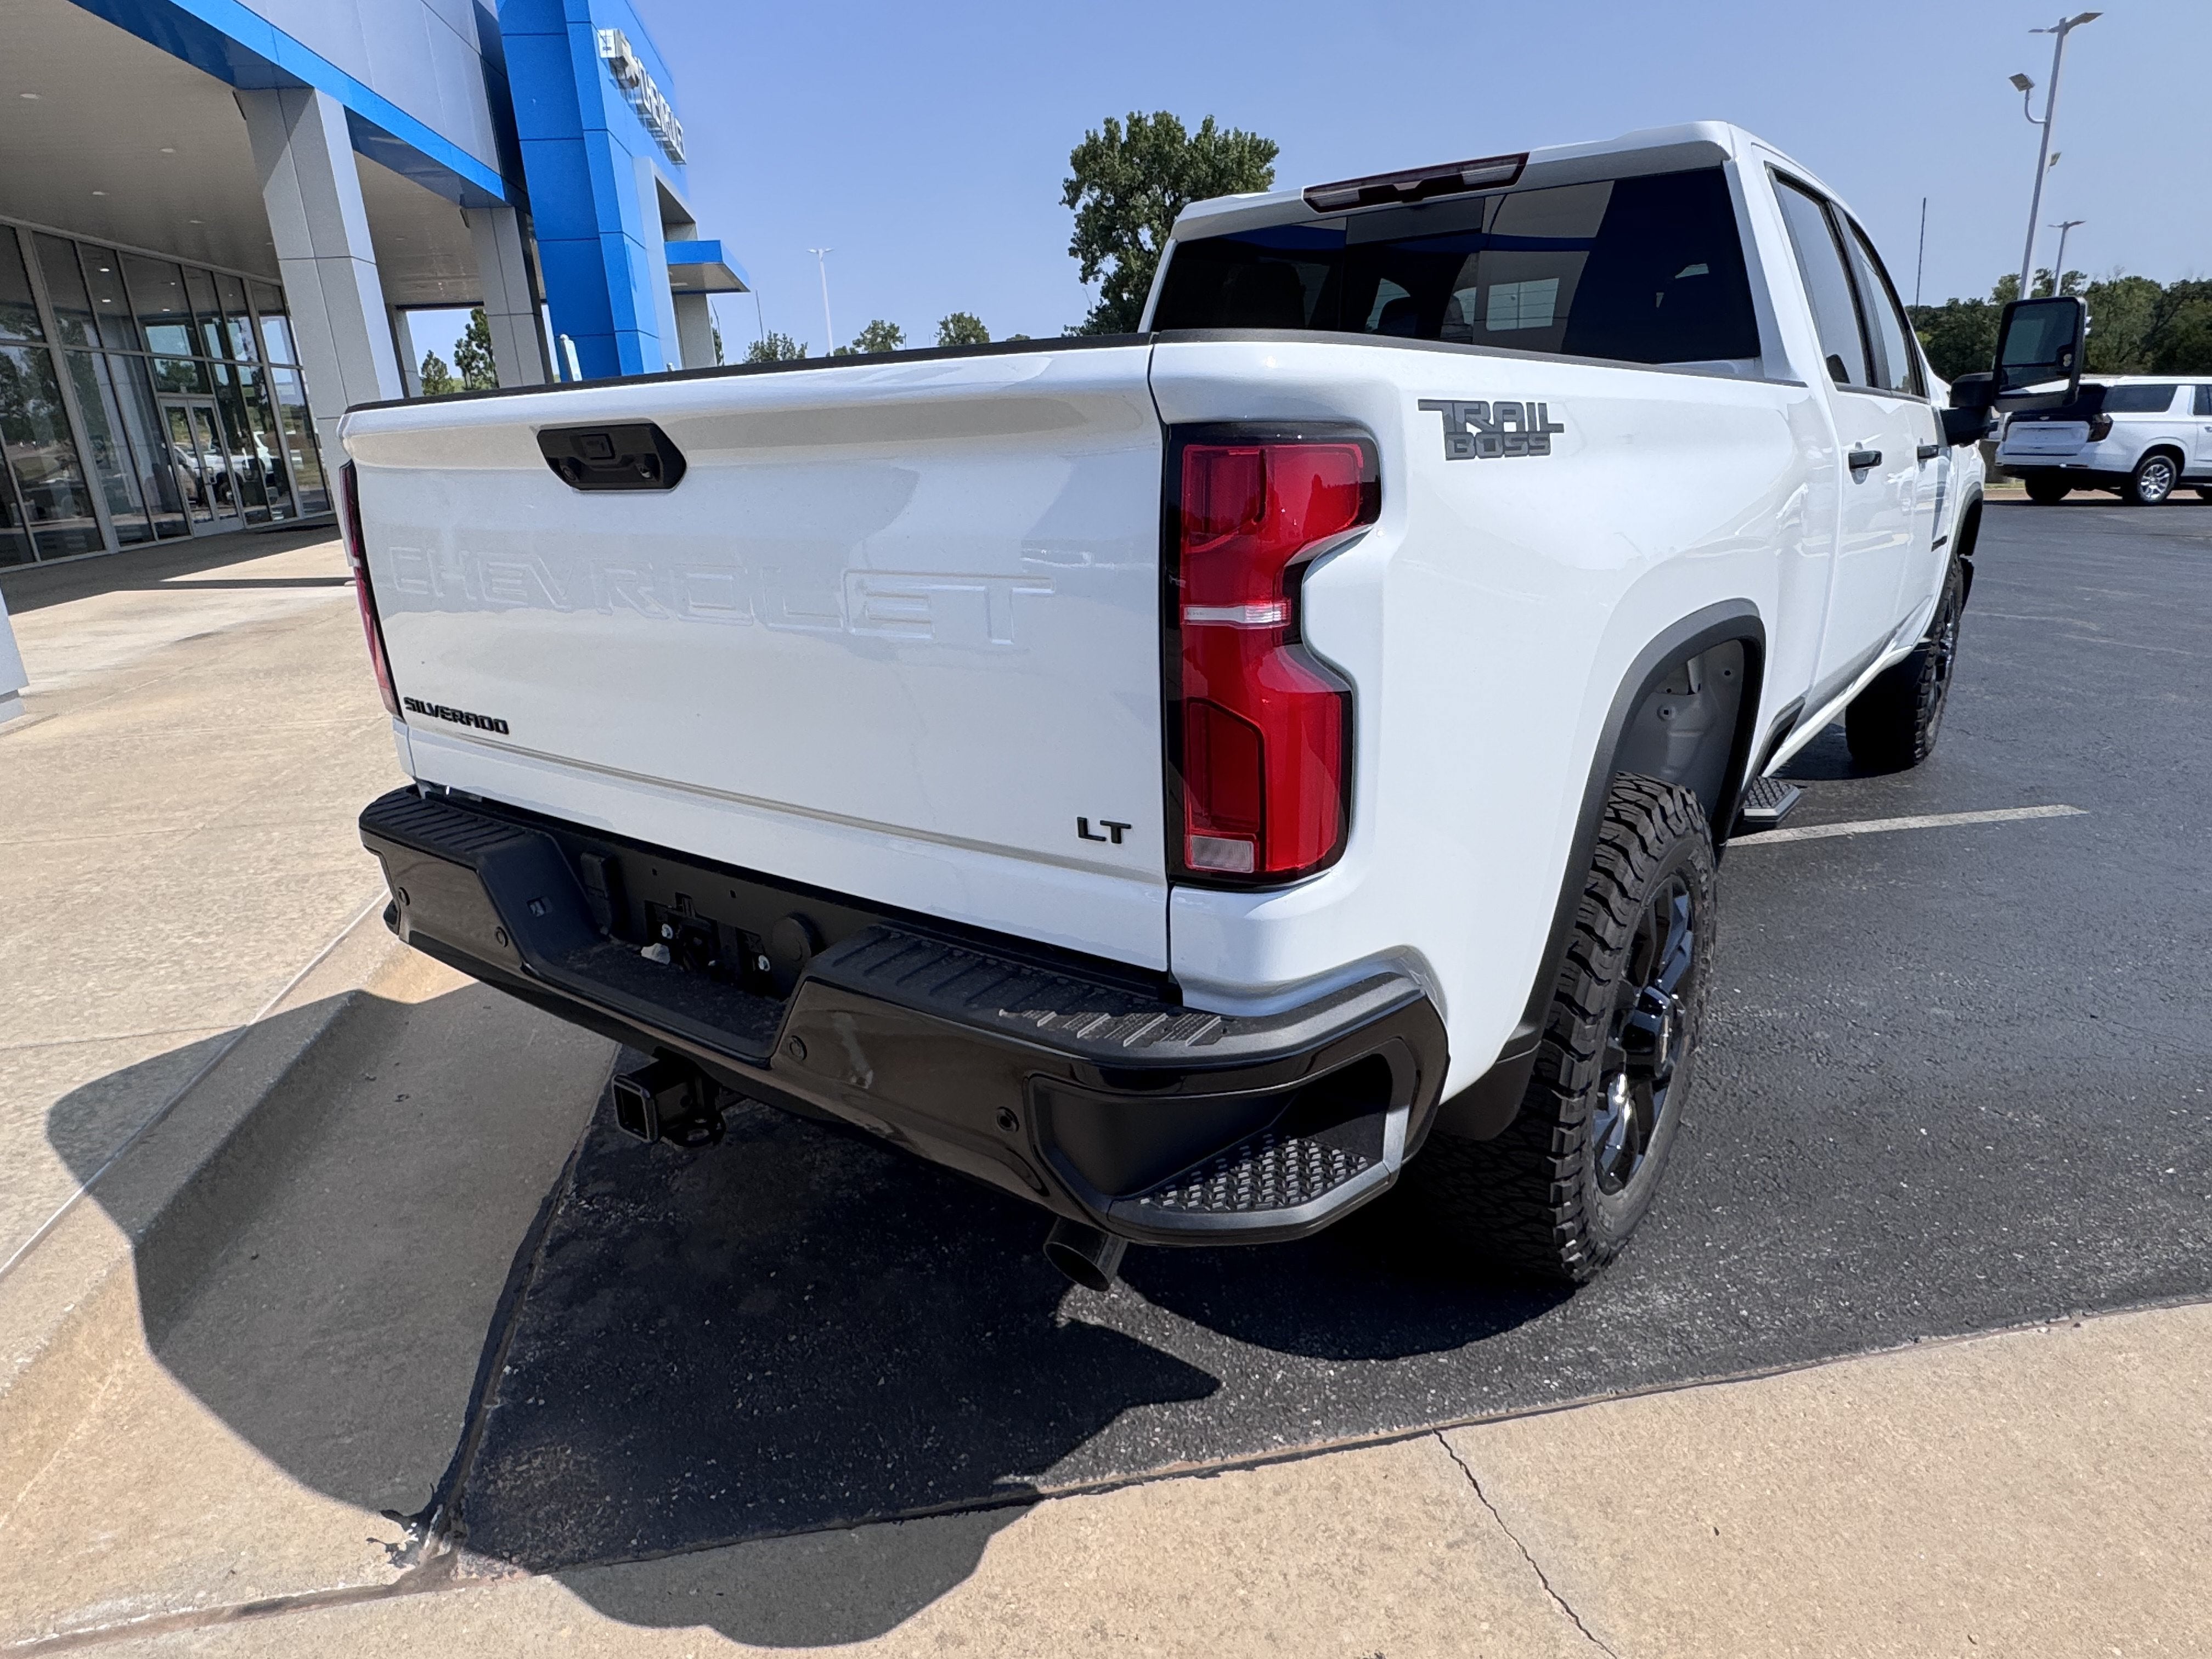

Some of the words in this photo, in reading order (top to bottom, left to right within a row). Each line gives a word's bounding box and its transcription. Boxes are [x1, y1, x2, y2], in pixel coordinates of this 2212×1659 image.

[1418, 399, 1565, 433] TRAIL
[1445, 431, 1551, 461] BOSS
[389, 546, 1054, 644] CHEVROLET
[403, 697, 509, 735] SILVERADO
[1077, 817, 1131, 844] LT
